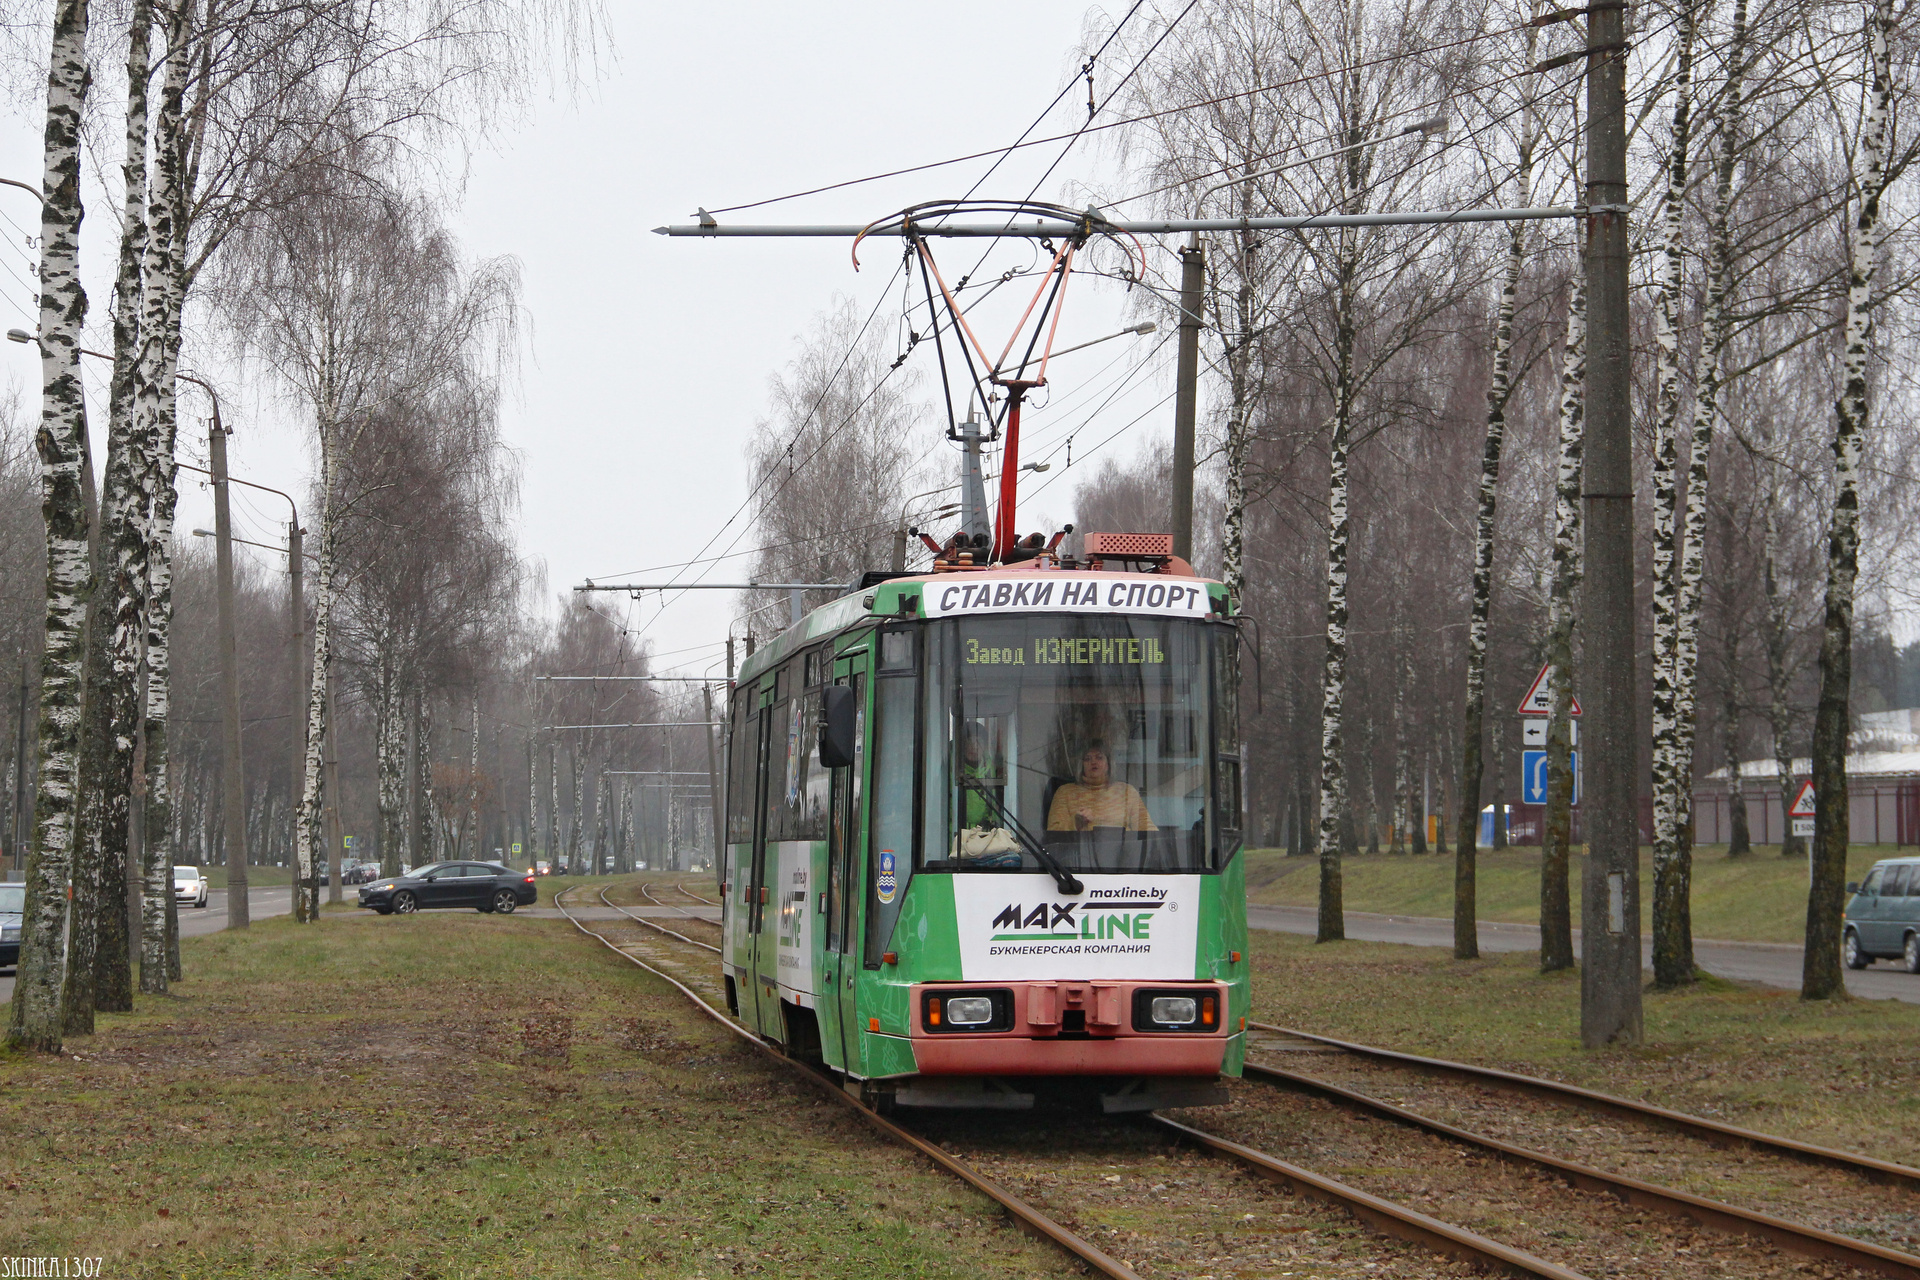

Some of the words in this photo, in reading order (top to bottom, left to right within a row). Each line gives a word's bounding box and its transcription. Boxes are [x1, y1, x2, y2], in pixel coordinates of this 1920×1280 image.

[939, 582, 1054, 611] СТАВКИ
[1060, 582, 1098, 606] НА
[1107, 582, 1201, 611] СПОРТ
[966, 638, 1024, 666] Завод
[1035, 637, 1165, 665] ИЗМЕРИТЕЛЬ
[1089, 886, 1168, 900] maxline.by
[989, 945, 1081, 956] БУКМЕКЕРСКАЯ
[1084, 944, 1151, 955] КОМПАНИЯ
